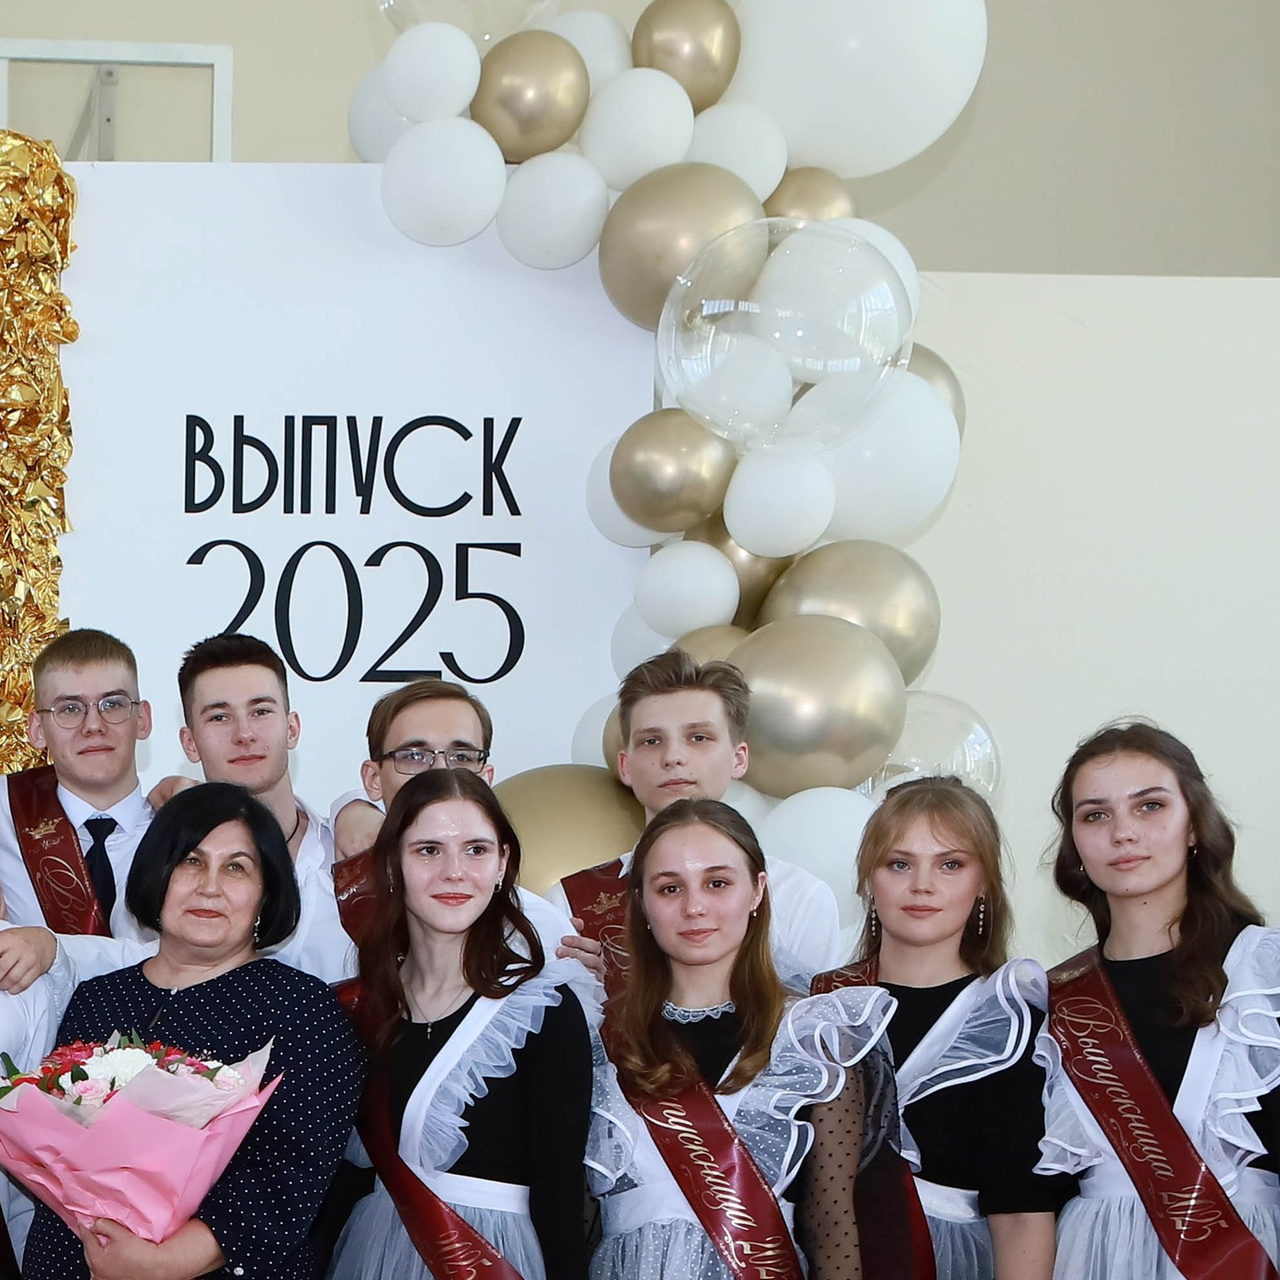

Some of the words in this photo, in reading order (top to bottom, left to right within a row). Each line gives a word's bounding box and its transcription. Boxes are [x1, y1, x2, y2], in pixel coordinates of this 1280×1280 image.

[184, 414, 523, 517] ВЫПУСК
[186, 539, 526, 684] 2025
[1053, 996, 1175, 1180] Выпускница
[1159, 1185, 1229, 1242] 2025
